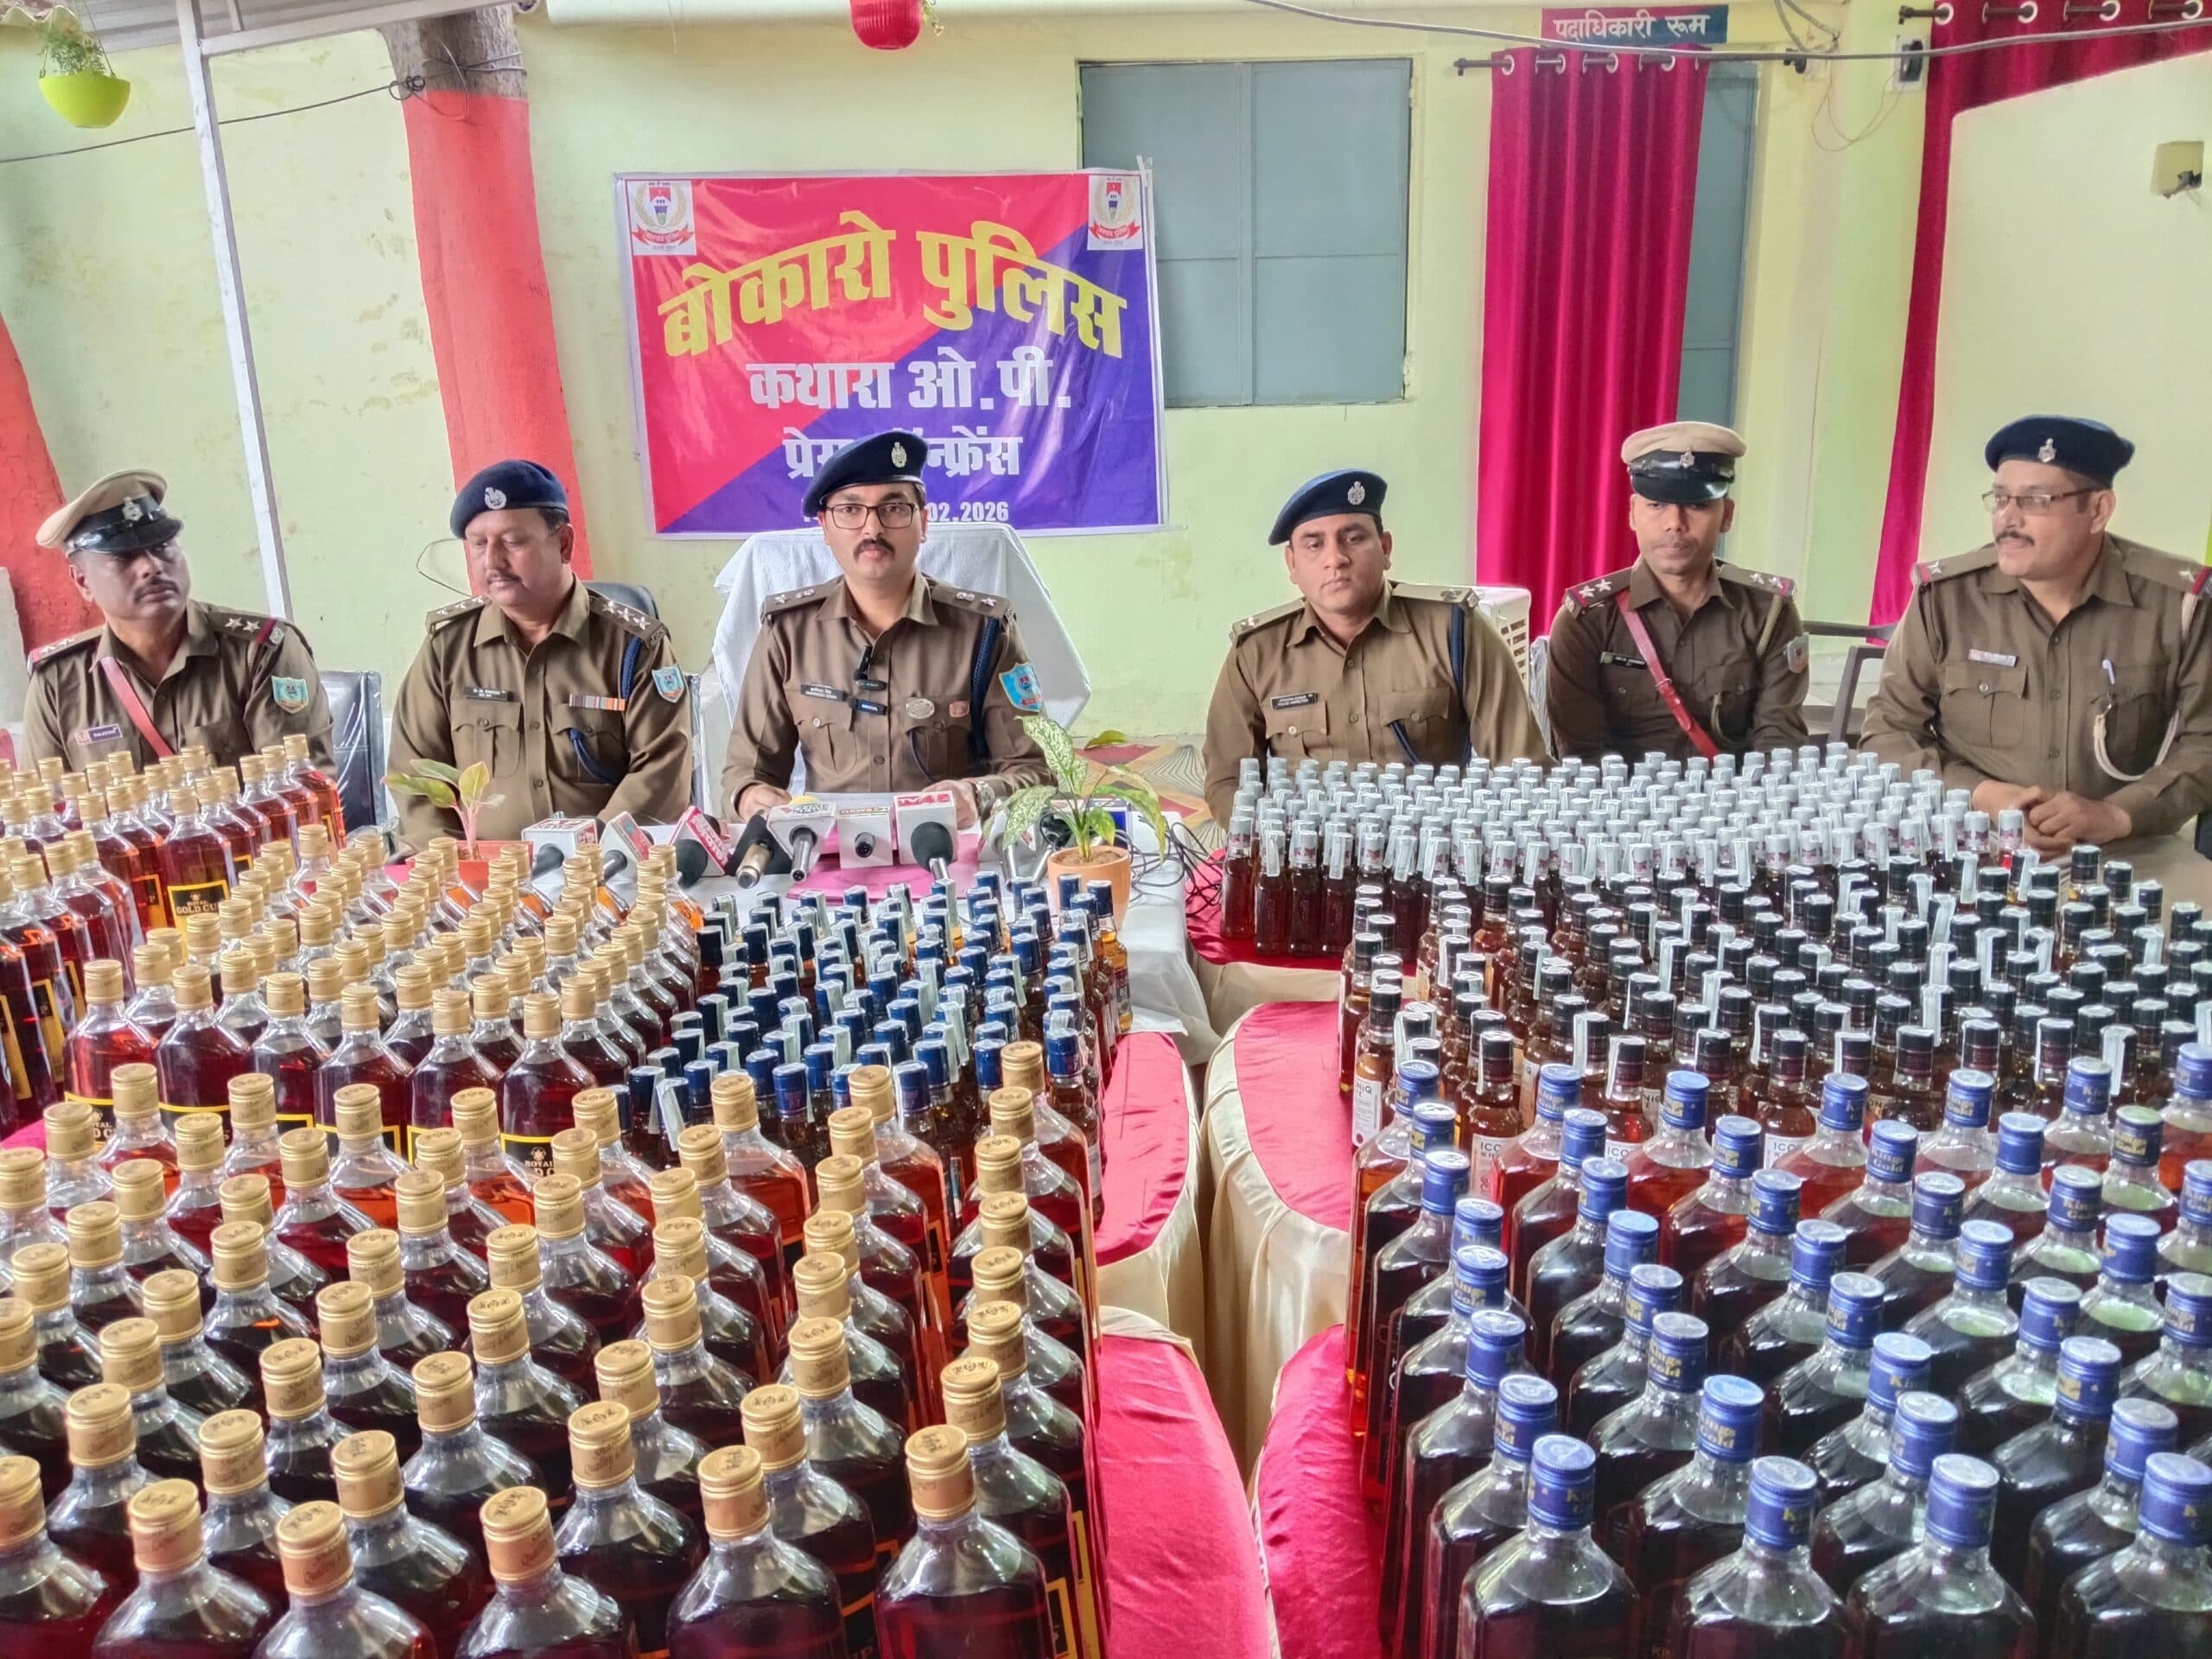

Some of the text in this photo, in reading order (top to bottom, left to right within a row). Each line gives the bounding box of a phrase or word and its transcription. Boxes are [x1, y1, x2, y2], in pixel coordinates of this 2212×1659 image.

[1553, 9, 1710, 41] पदाधिकारी रूम
[658, 210, 1128, 359] बोकारो पुलिस
[746, 362, 895, 410] कथारा
[176, 903, 219, 914] GOLD CU
[1480, 1142, 1502, 1153] ICO
[1773, 1141, 1796, 1151] ICO
[1607, 1147, 1629, 1157] ICO
